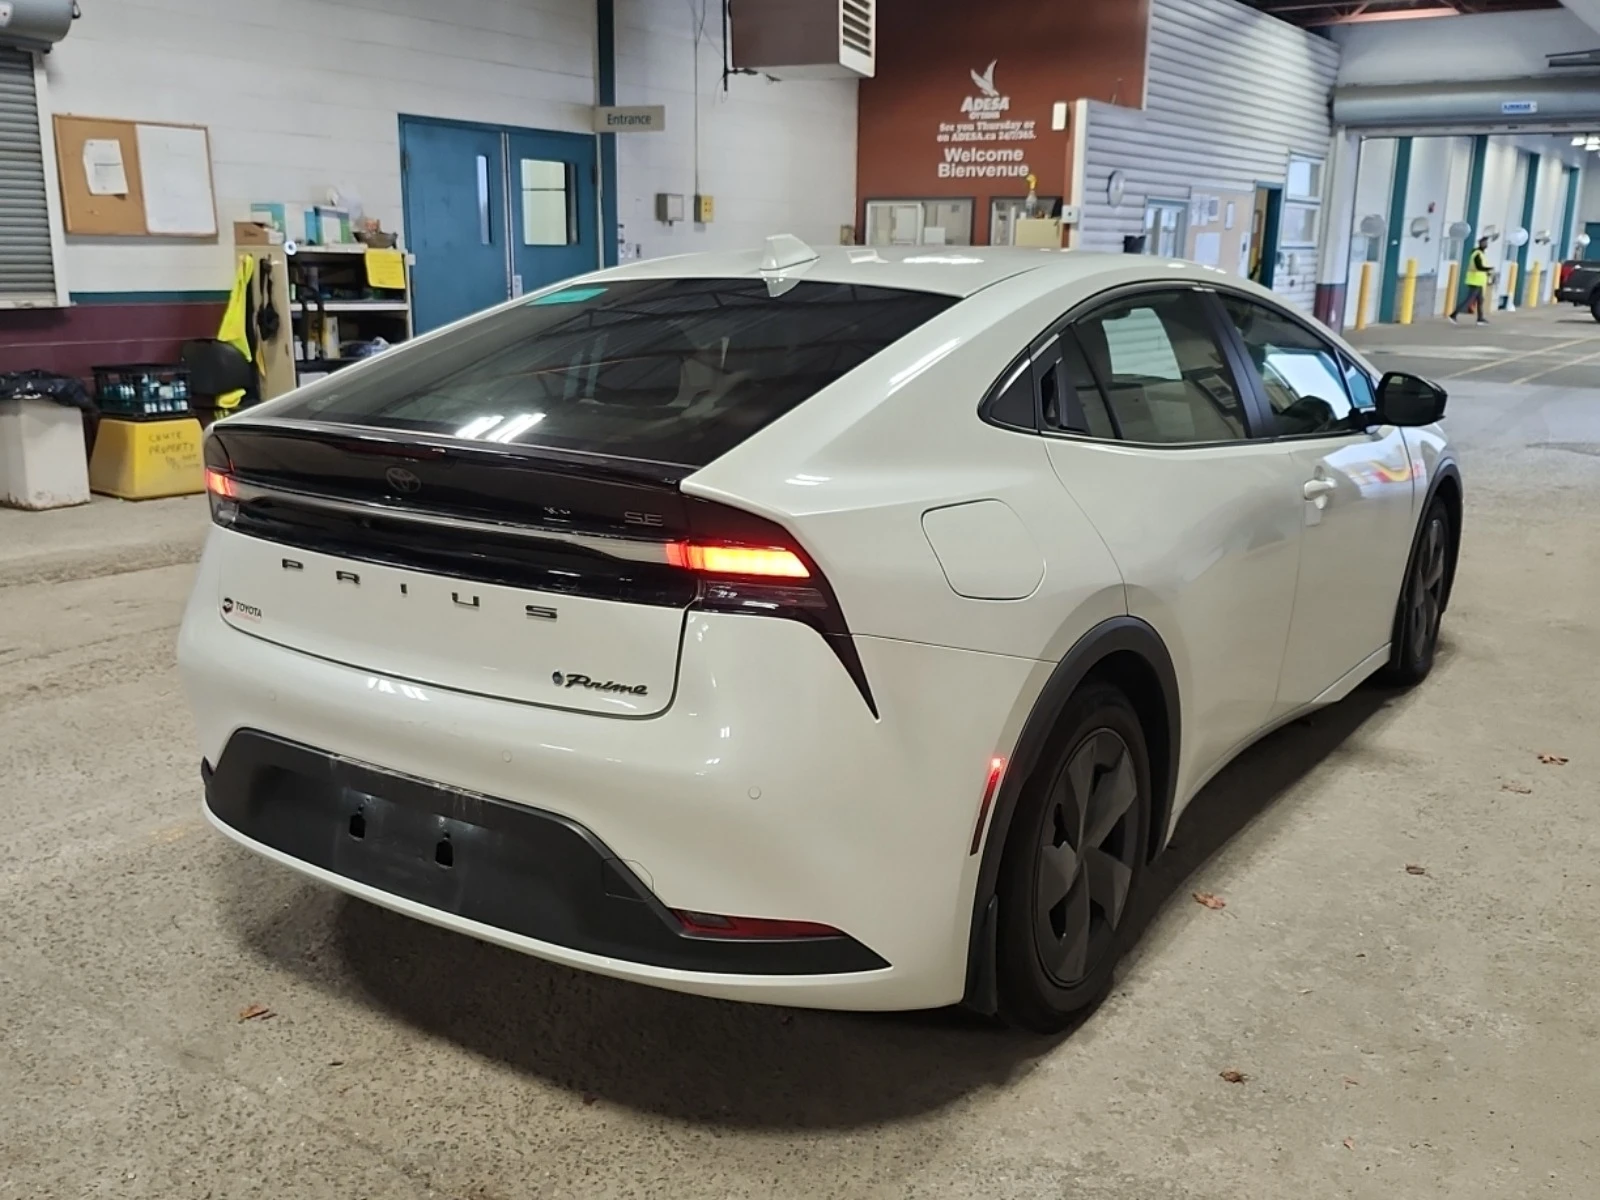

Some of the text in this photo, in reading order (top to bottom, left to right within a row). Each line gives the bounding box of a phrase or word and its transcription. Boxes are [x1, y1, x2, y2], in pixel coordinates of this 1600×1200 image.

[960, 96, 1010, 112] ADESA
[607, 113, 652, 125] Entrance
[957, 123, 975, 134] you
[976, 120, 1022, 133] Thursday
[951, 130, 997, 142] ADESA.ca
[944, 147, 1024, 162] Welcome
[938, 162, 1030, 178] Bienvenue
[624, 511, 664, 527] SE
[282, 558, 558, 620] PRIUS
[236, 601, 262, 618] TOYOTA
[565, 673, 648, 696] Prime
